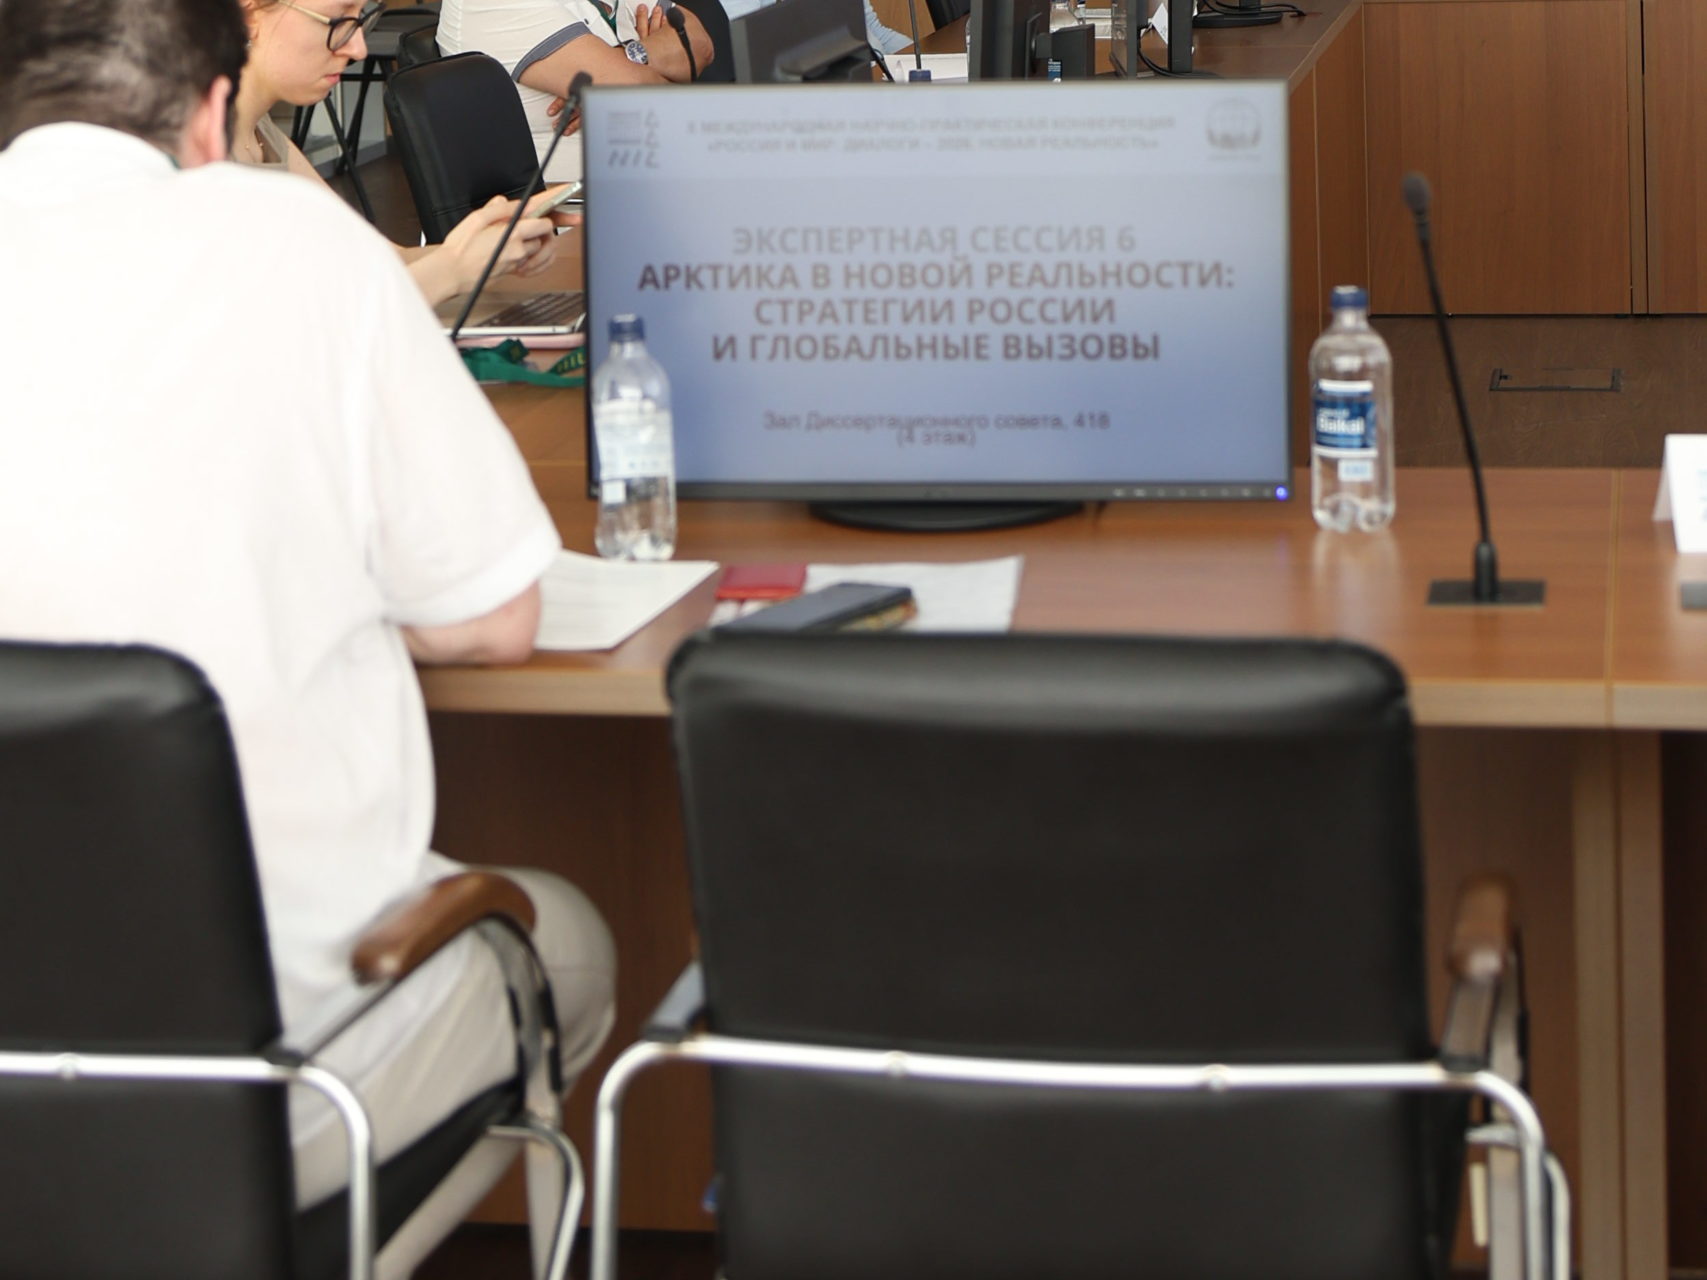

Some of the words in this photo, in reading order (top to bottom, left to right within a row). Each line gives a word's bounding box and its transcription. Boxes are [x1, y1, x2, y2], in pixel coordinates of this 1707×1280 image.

[733, 226, 957, 254] ЭКСПЕРТНАЯ
[970, 225, 1105, 253] СЕССИЯ
[1116, 225, 1136, 252] 6
[638, 264, 800, 290] АРКТИКА
[811, 264, 831, 289] В
[844, 254, 973, 289] НОВОЙ
[986, 261, 1234, 289] РЕАЛЬНОСТИ:
[754, 299, 955, 325] СТРАТЕГИИ
[967, 298, 1116, 324] РОССИИ
[712, 335, 737, 361] И
[750, 334, 990, 360] ГЛОБАЛЬНЫЕ
[1003, 333, 1160, 360] ВЫЗОВЫ
[763, 411, 800, 431] Зал
